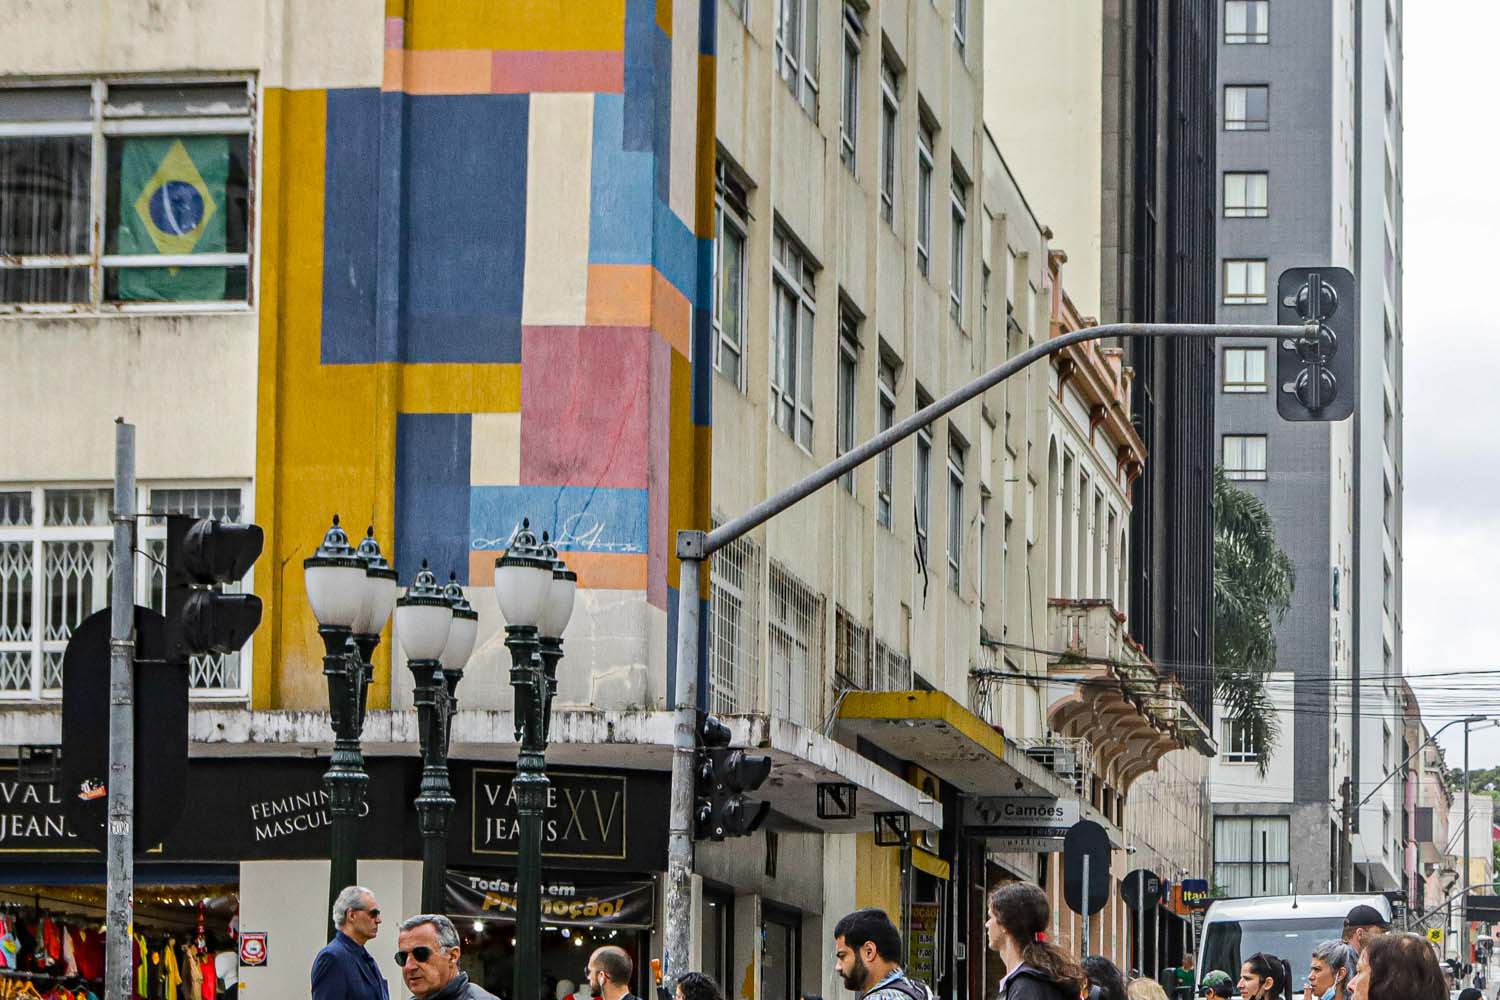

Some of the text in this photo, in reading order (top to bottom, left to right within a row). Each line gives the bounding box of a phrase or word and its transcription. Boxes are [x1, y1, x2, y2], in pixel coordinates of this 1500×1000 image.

[484, 784, 558, 809] VAE
[0, 815, 77, 842] JEAN
[562, 788, 621, 843] XV
[485, 817, 558, 844] JEAS
[469, 876, 510, 893] Toda
[548, 884, 576, 896] em
[1184, 891, 1207, 902] Itaú
